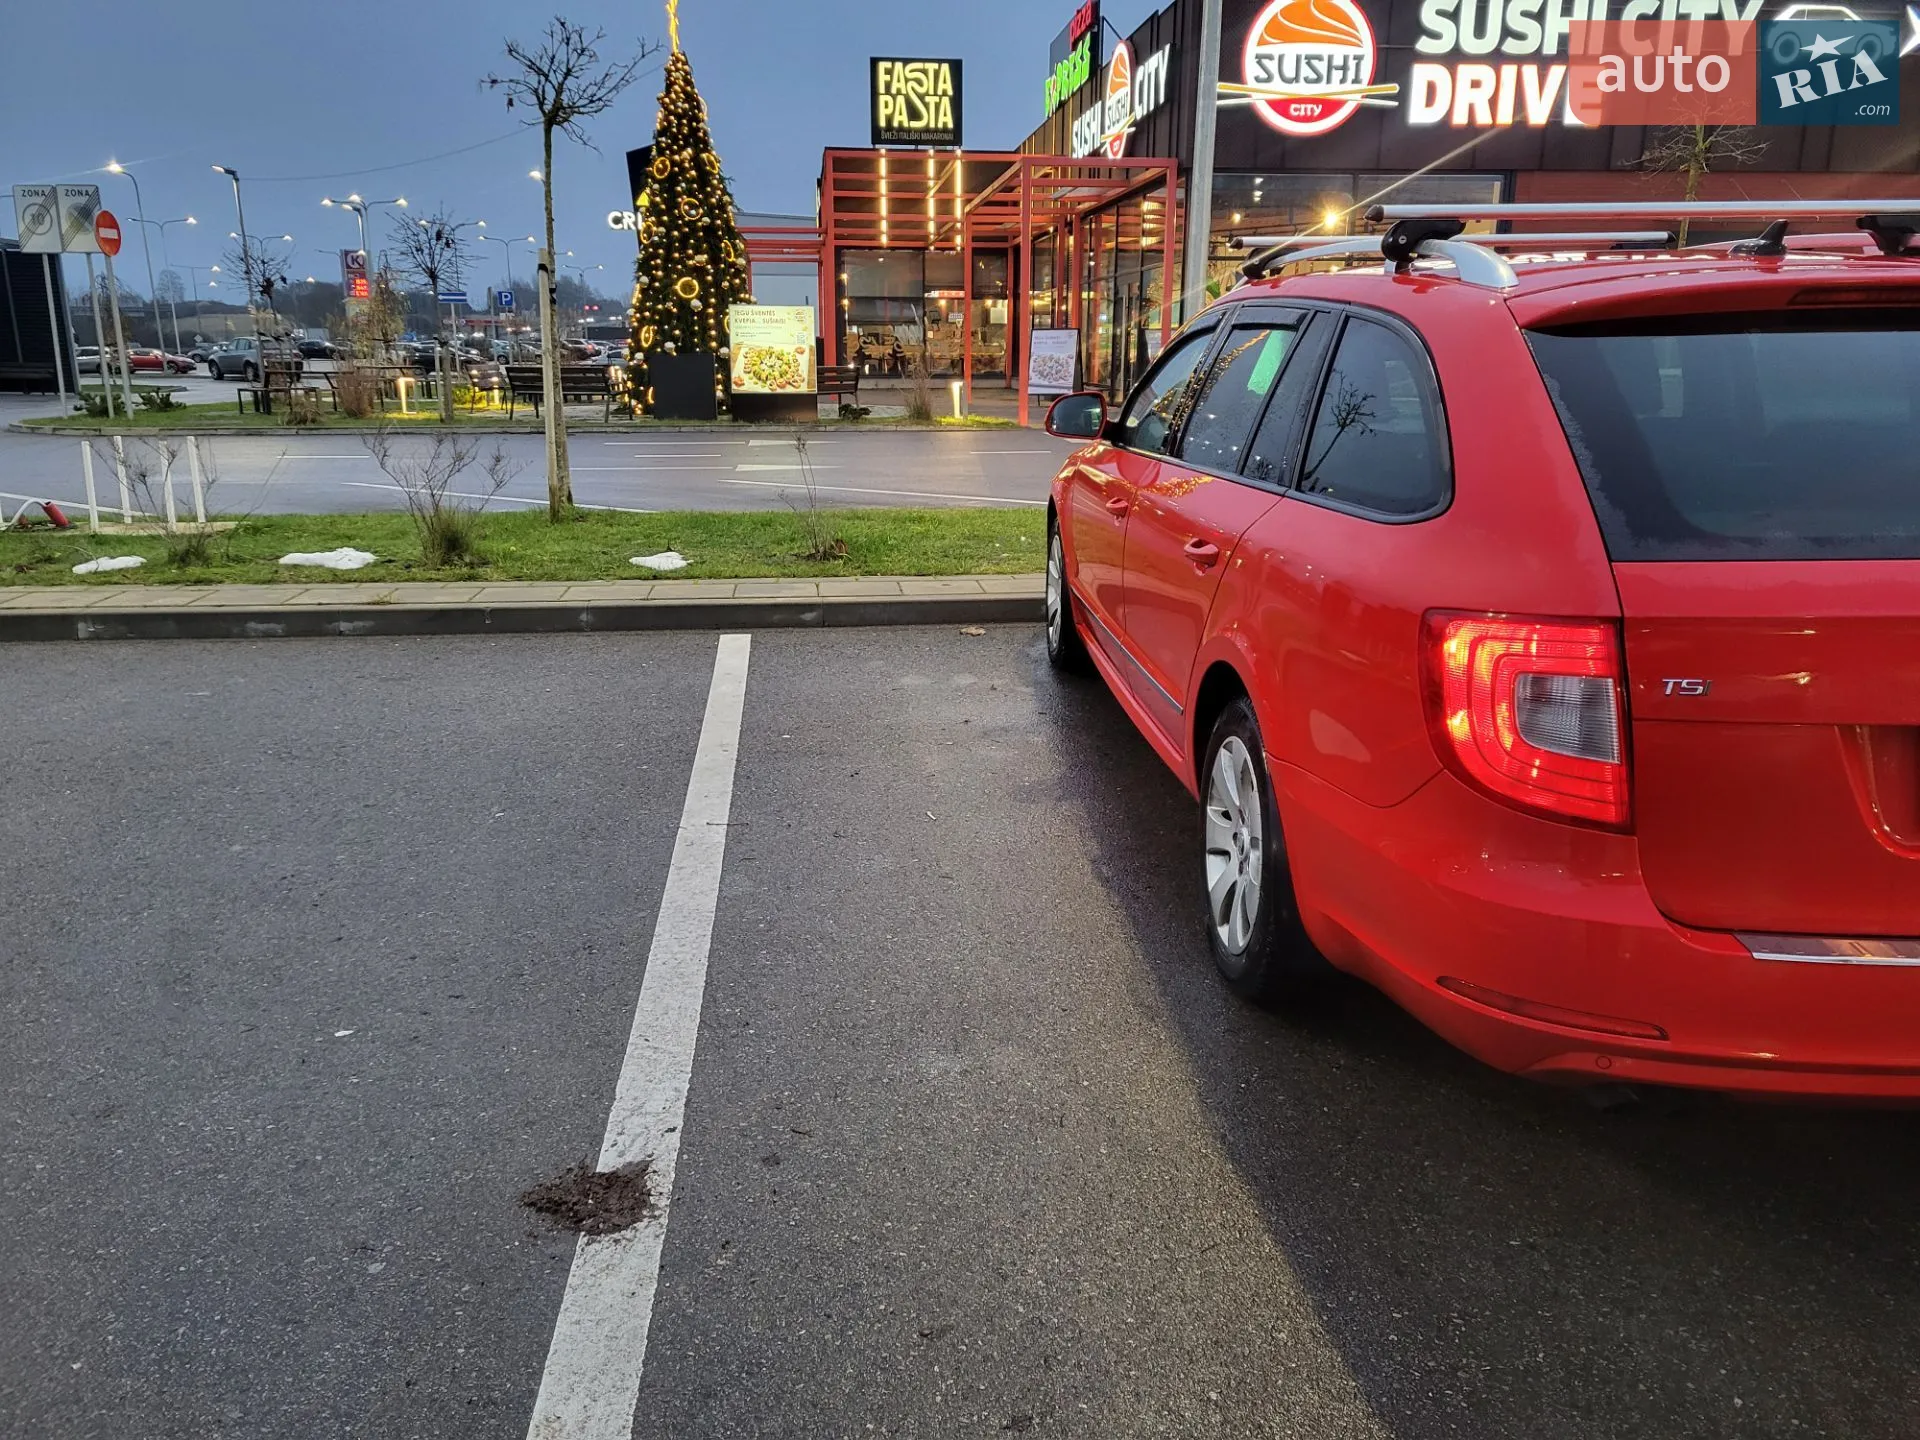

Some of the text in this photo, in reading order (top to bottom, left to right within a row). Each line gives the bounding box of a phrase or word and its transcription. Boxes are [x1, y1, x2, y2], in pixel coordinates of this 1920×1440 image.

[1415, 0, 1762, 57] SUSHI CITY
[878, 61, 953, 96] FASTA
[1254, 53, 1366, 85] SUSHI
[878, 94, 954, 129] PASTA
[1072, 43, 1171, 159] SUSHI CITY
[1107, 91, 1129, 131] SUSHI
[1290, 103, 1323, 116] CITY
[1408, 63, 1603, 127] DRIVE
[21, 189, 47, 198] ZONA
[64, 188, 91, 197] ZONA
[502, 293, 511, 305] P
[1662, 679, 1711, 696] TSI
